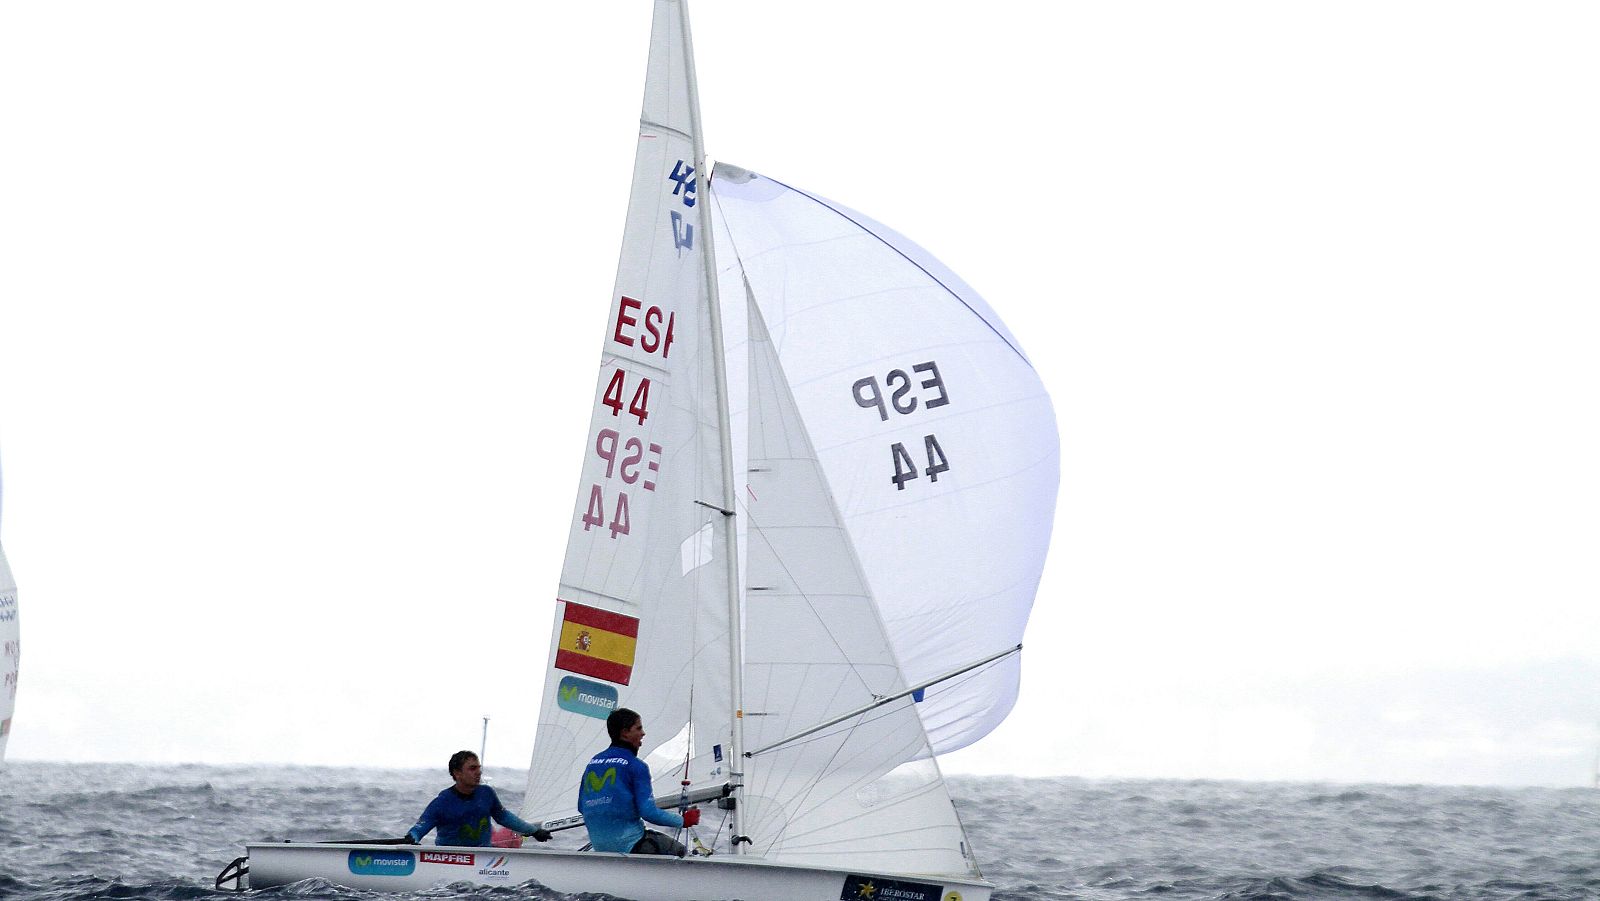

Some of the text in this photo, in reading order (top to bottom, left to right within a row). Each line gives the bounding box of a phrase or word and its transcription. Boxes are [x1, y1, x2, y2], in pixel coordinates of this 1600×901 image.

[602, 368, 651, 426] 44
[578, 692, 616, 709] movistar
[373, 858, 410, 867] movistar
[424, 853, 471, 864] MAPFRE
[479, 868, 510, 876] alicante
[880, 887, 925, 900] IBEROSTAR
